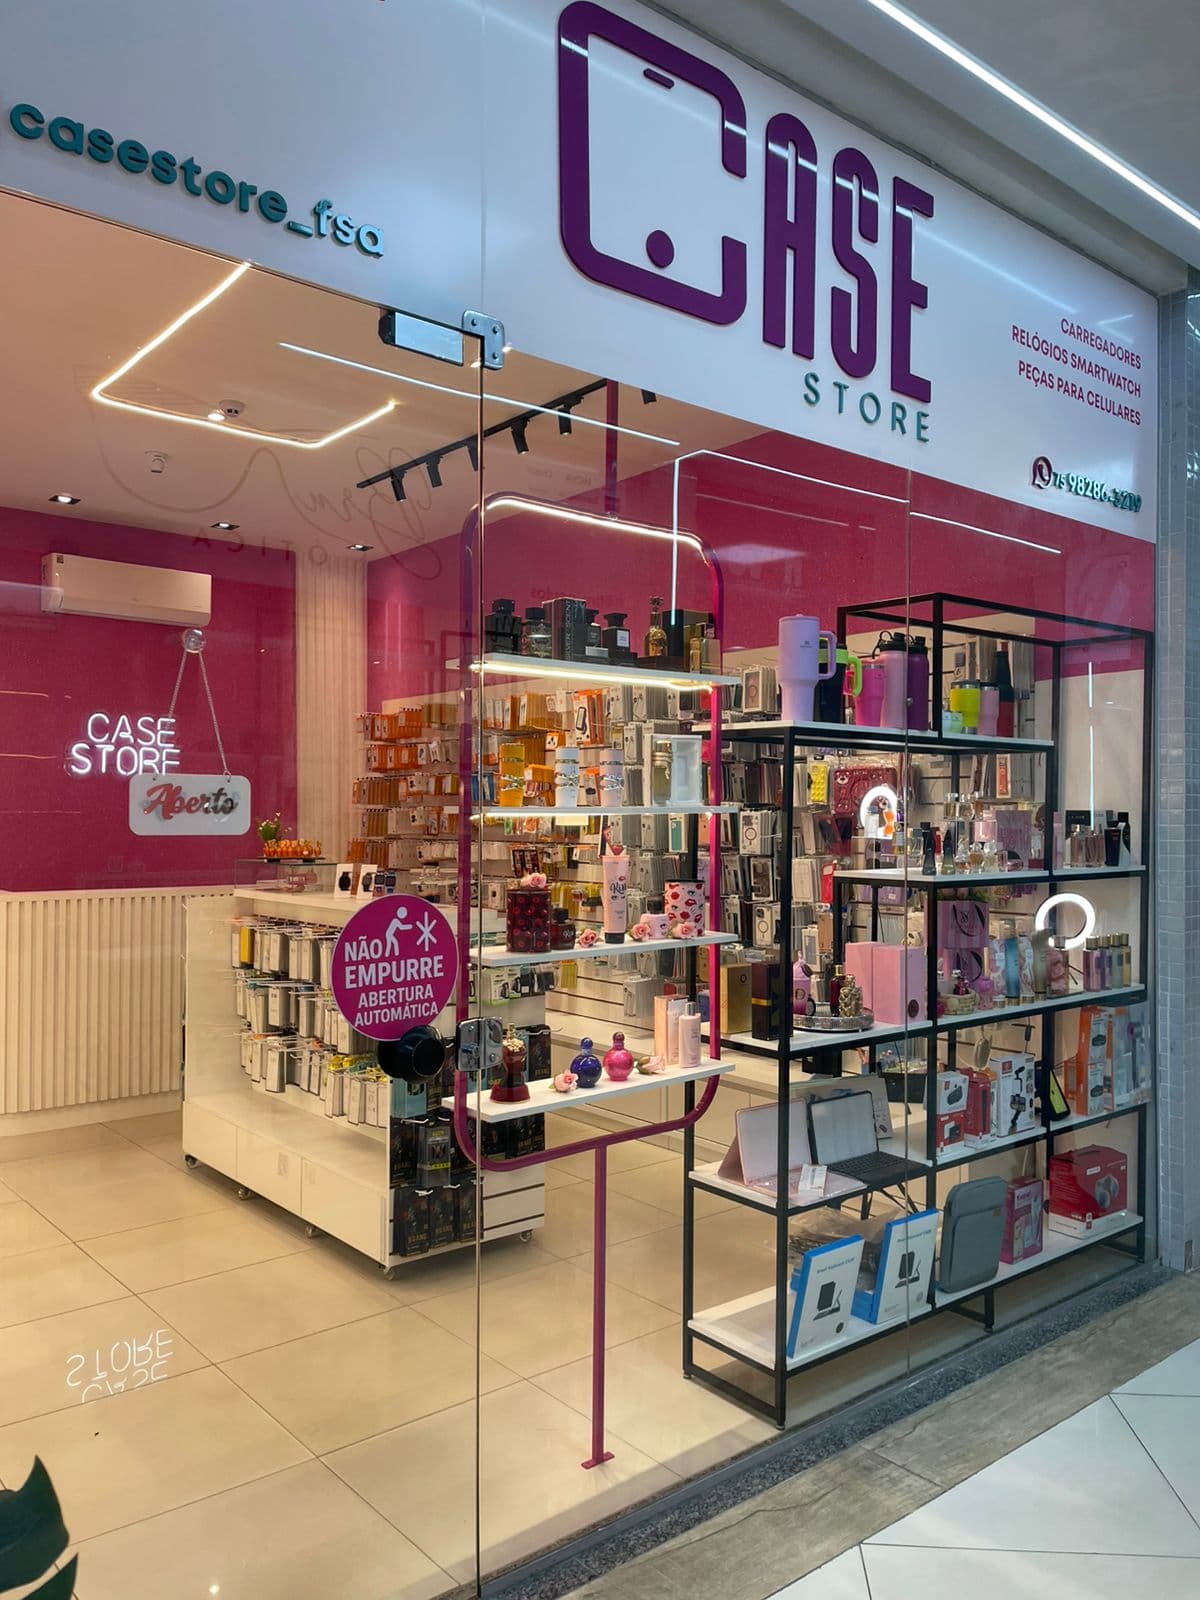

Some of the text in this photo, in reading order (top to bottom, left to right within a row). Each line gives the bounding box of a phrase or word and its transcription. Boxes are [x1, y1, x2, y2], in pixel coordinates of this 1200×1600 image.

[9, 103, 385, 257] casestore_fsa
[558, 1, 934, 404] CASE
[1011, 325, 1141, 398] RELÓGIOS SMARTWATCH
[1060, 318, 1142, 370] CARREGADORES
[803, 372, 930, 443] STORE
[1018, 360, 1141, 426] PEÇAS PARA CELULARES
[87, 713, 176, 748] CASE
[71, 743, 181, 776] STORE
[143, 783, 239, 821] Aberto
[344, 935, 383, 963] NÃO
[345, 955, 444, 990] EMPURRE
[355, 1001, 439, 1027] AUTOMÁTICA
[358, 984, 434, 1009] ABERTURA
